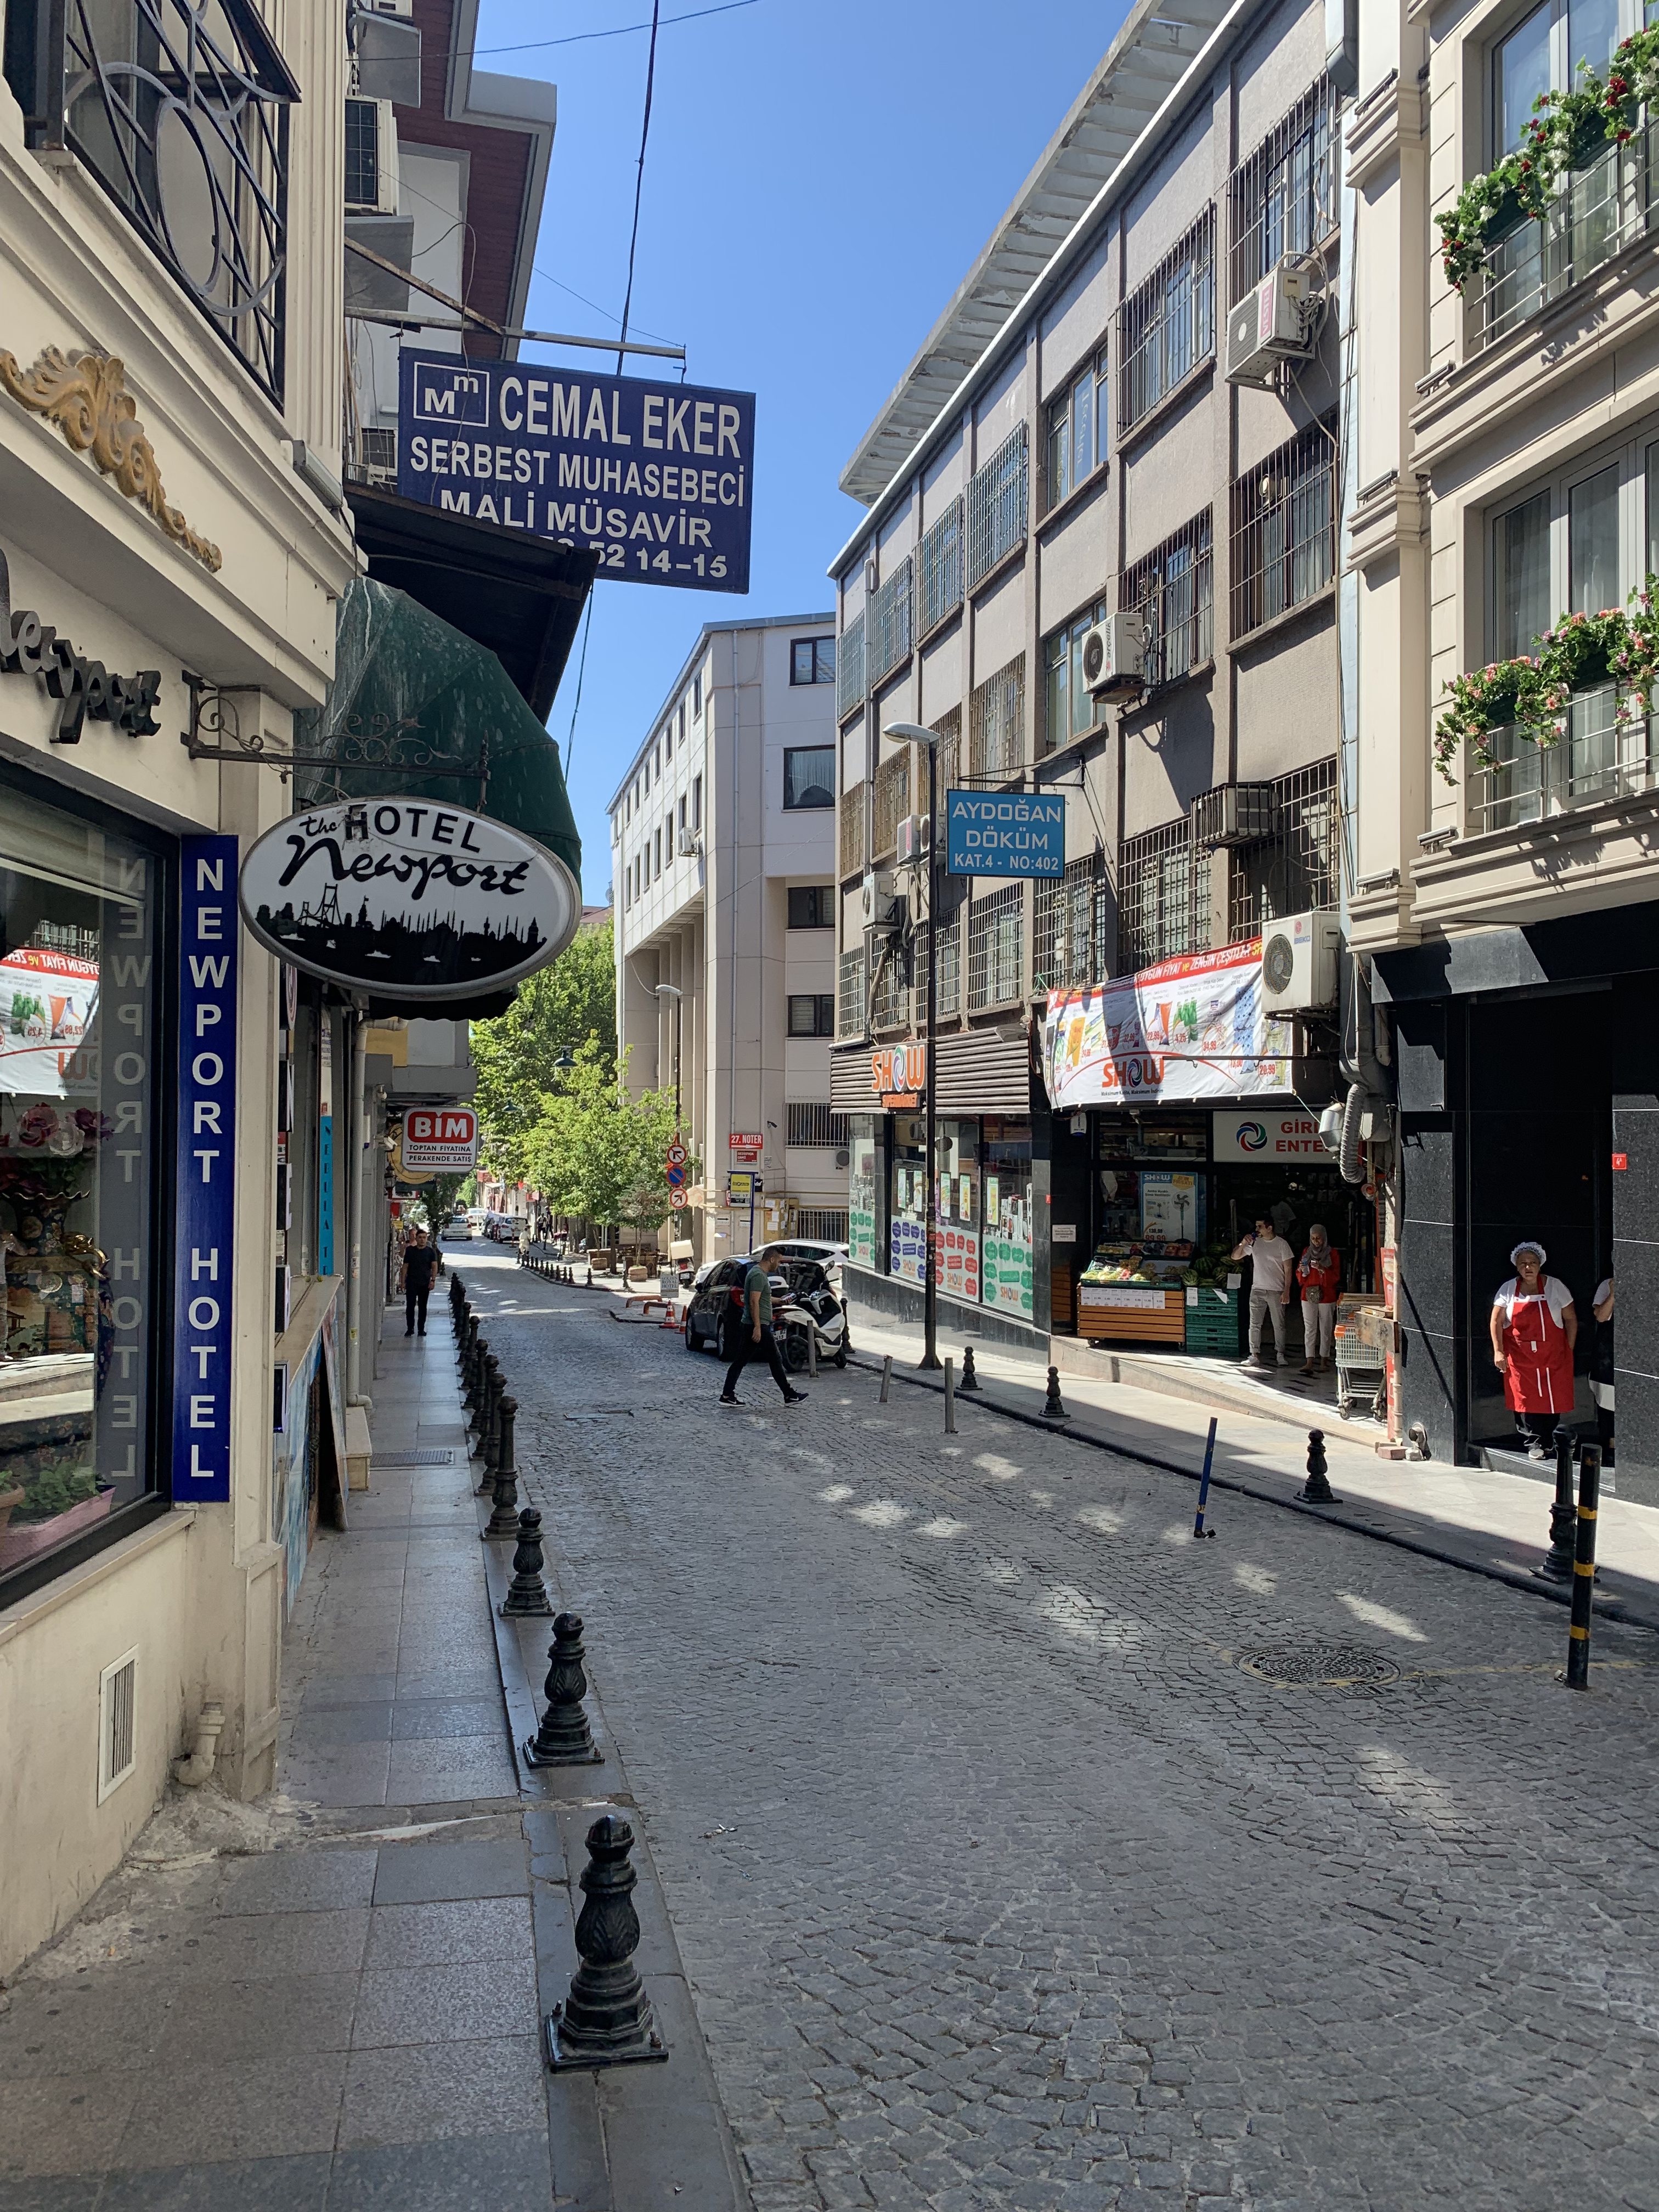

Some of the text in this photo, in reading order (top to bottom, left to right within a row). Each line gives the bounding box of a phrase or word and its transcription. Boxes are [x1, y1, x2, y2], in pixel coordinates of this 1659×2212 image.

[499, 377, 631, 445] CEMAL
[643, 394, 741, 459] EKER
[410, 436, 744, 507] SERBEST MUHASEBECİ
[441, 489, 713, 548] MALİ MÜSAVİR
[952, 798, 1061, 823] AYDOĞAN
[299, 804, 481, 853] the HOTEL
[966, 825, 1048, 850] DÖKÜM
[279, 834, 531, 900] Newport
[955, 853, 993, 868] KAT.4
[1009, 855, 1059, 871] NO:402
[1294, 935, 1311, 945] BEKO
[1182, 963, 1190, 973] ve
[189, 859, 230, 1182] NEWPORT
[872, 1044, 925, 1092] SHOW
[1102, 1058, 1164, 1088] SHOW
[1260, 1064, 1276, 1075] 20,99
[1280, 1119, 1319, 1134] GİRİ
[731, 1135, 762, 1144] 27. NOTER
[1276, 1140, 1330, 1152] ENTE
[1000, 1286, 1018, 1301] SHOW
[188, 1248, 220, 1477] HOTEL
